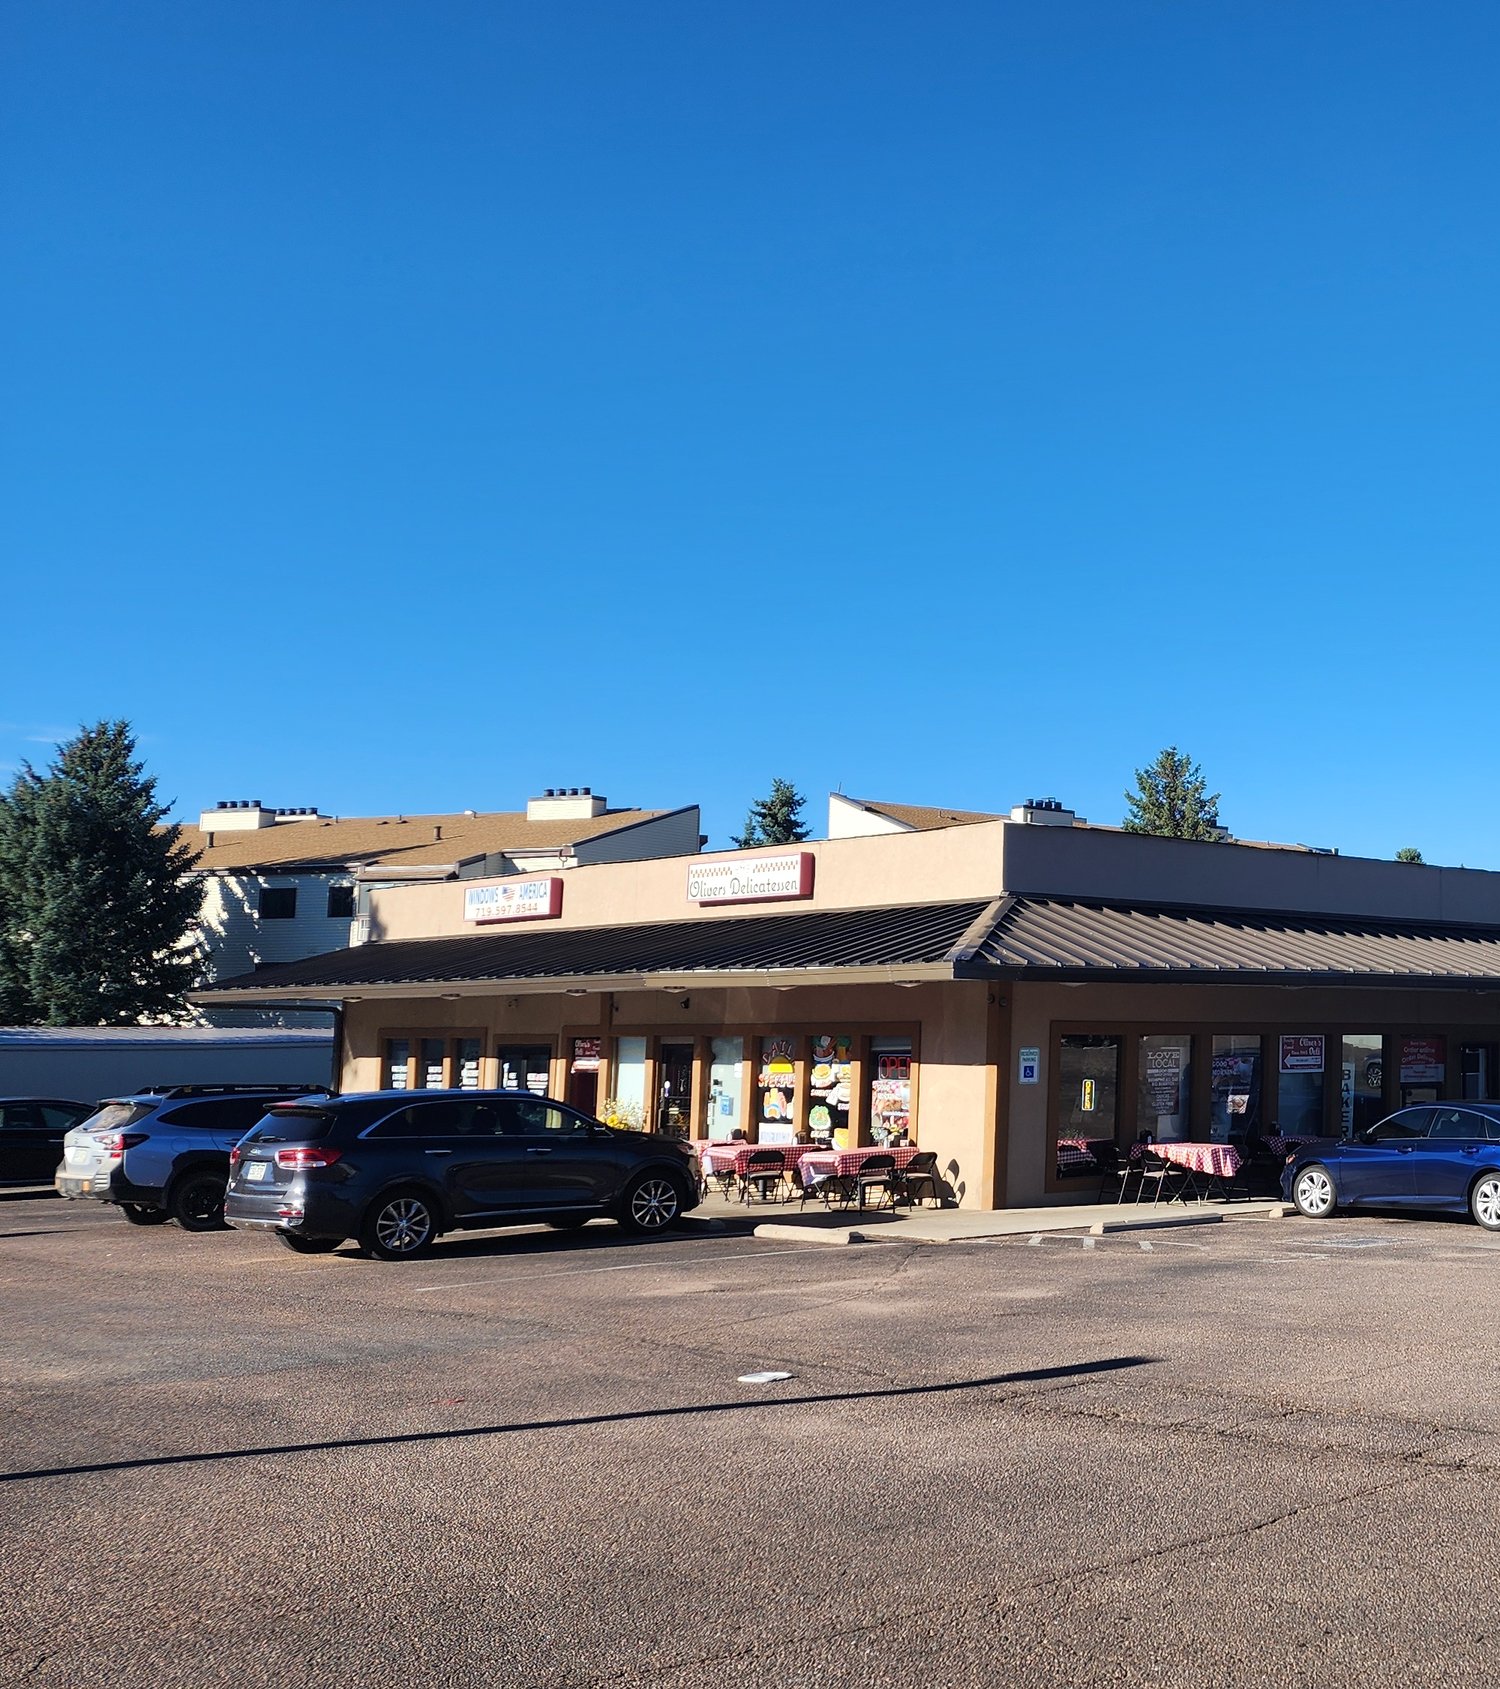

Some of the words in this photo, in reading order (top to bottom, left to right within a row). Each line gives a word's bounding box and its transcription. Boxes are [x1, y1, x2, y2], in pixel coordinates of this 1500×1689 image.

[469, 887, 499, 906] WINDOWS
[519, 882, 548, 900] AMERICA
[689, 880, 726, 898] Olivers
[730, 877, 798, 895] Delicatessen
[762, 1041, 795, 1064] DAIL
[1152, 1059, 1176, 1068] LOCAL
[758, 1073, 795, 1087] SPECIAL
